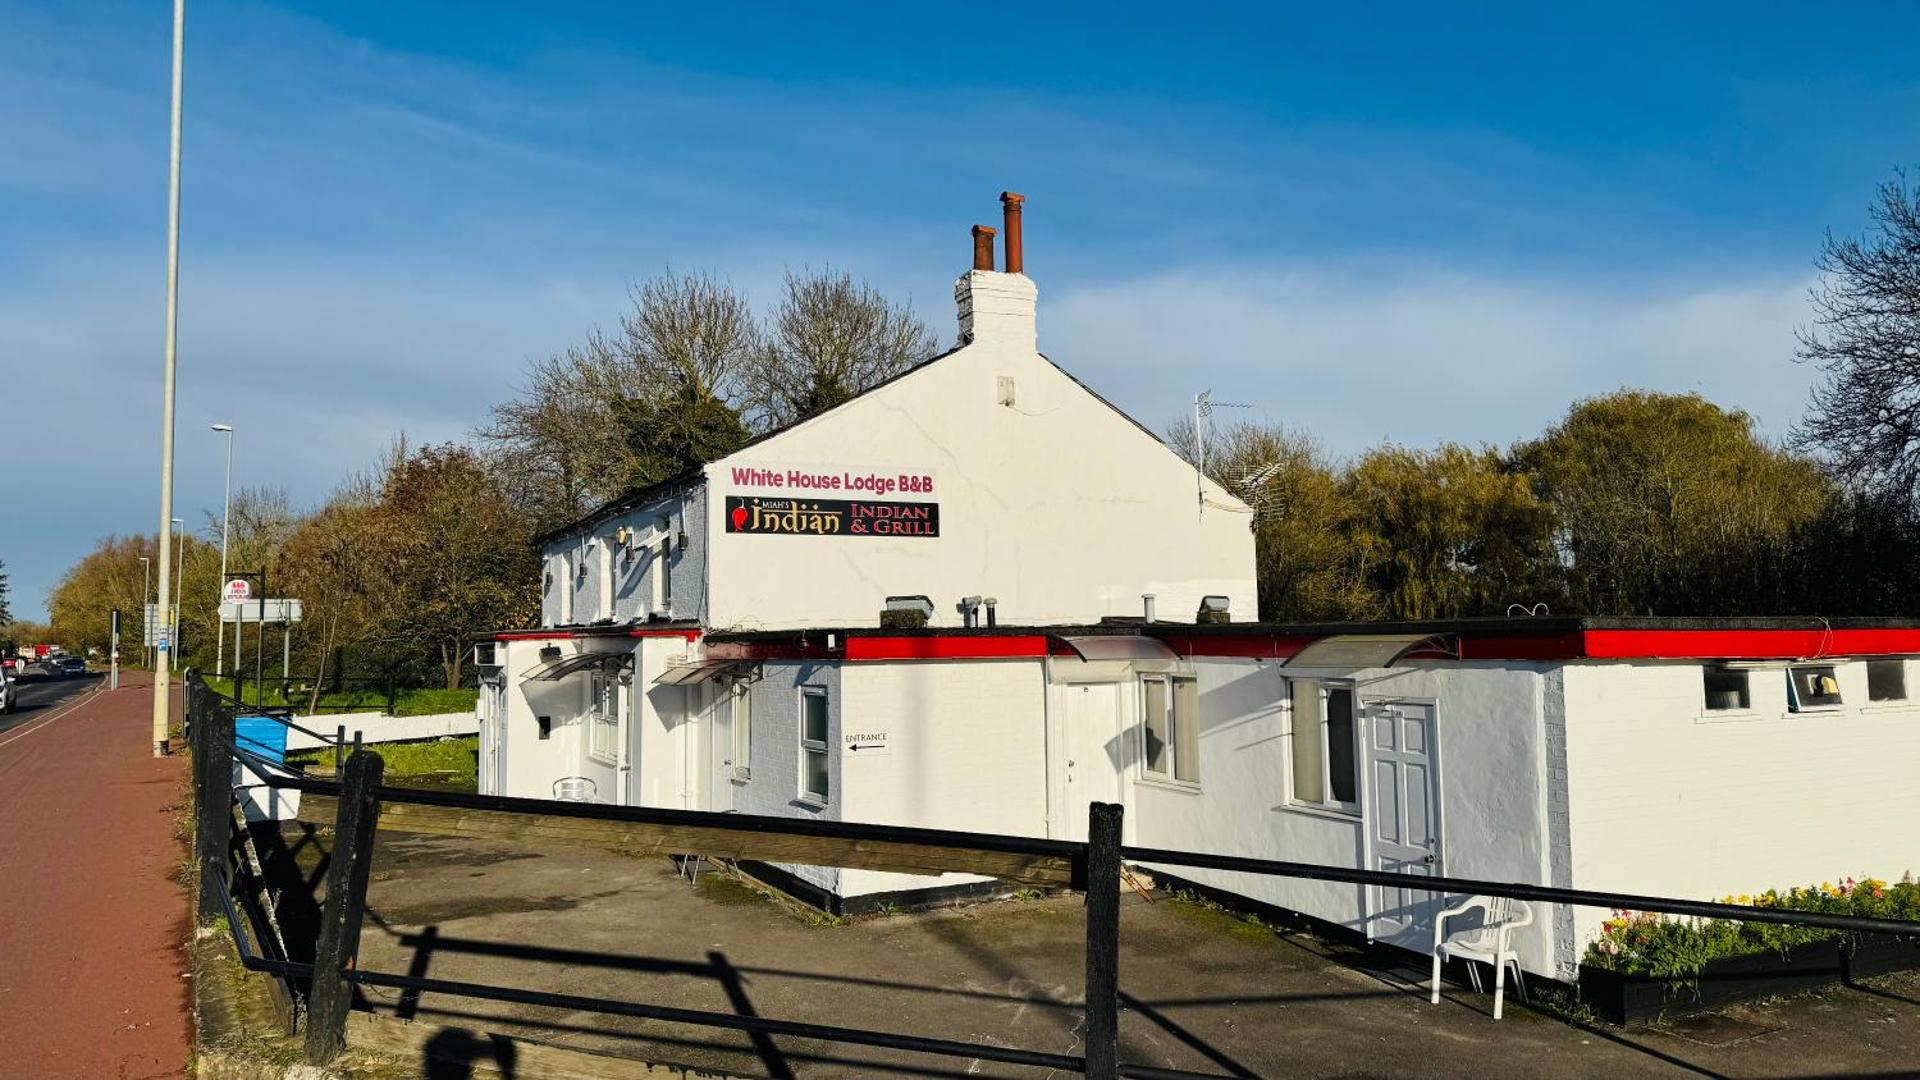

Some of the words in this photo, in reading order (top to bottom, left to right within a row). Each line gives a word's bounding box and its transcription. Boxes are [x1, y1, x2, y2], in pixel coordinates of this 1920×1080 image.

[732, 467, 783, 487] White
[787, 470, 841, 489] House
[844, 472, 895, 495] Lodge
[898, 475, 933, 493] B&B
[762, 501, 790, 509] MIAH'S
[850, 519, 869, 533] &
[845, 732, 887, 743] ENTRANCE
